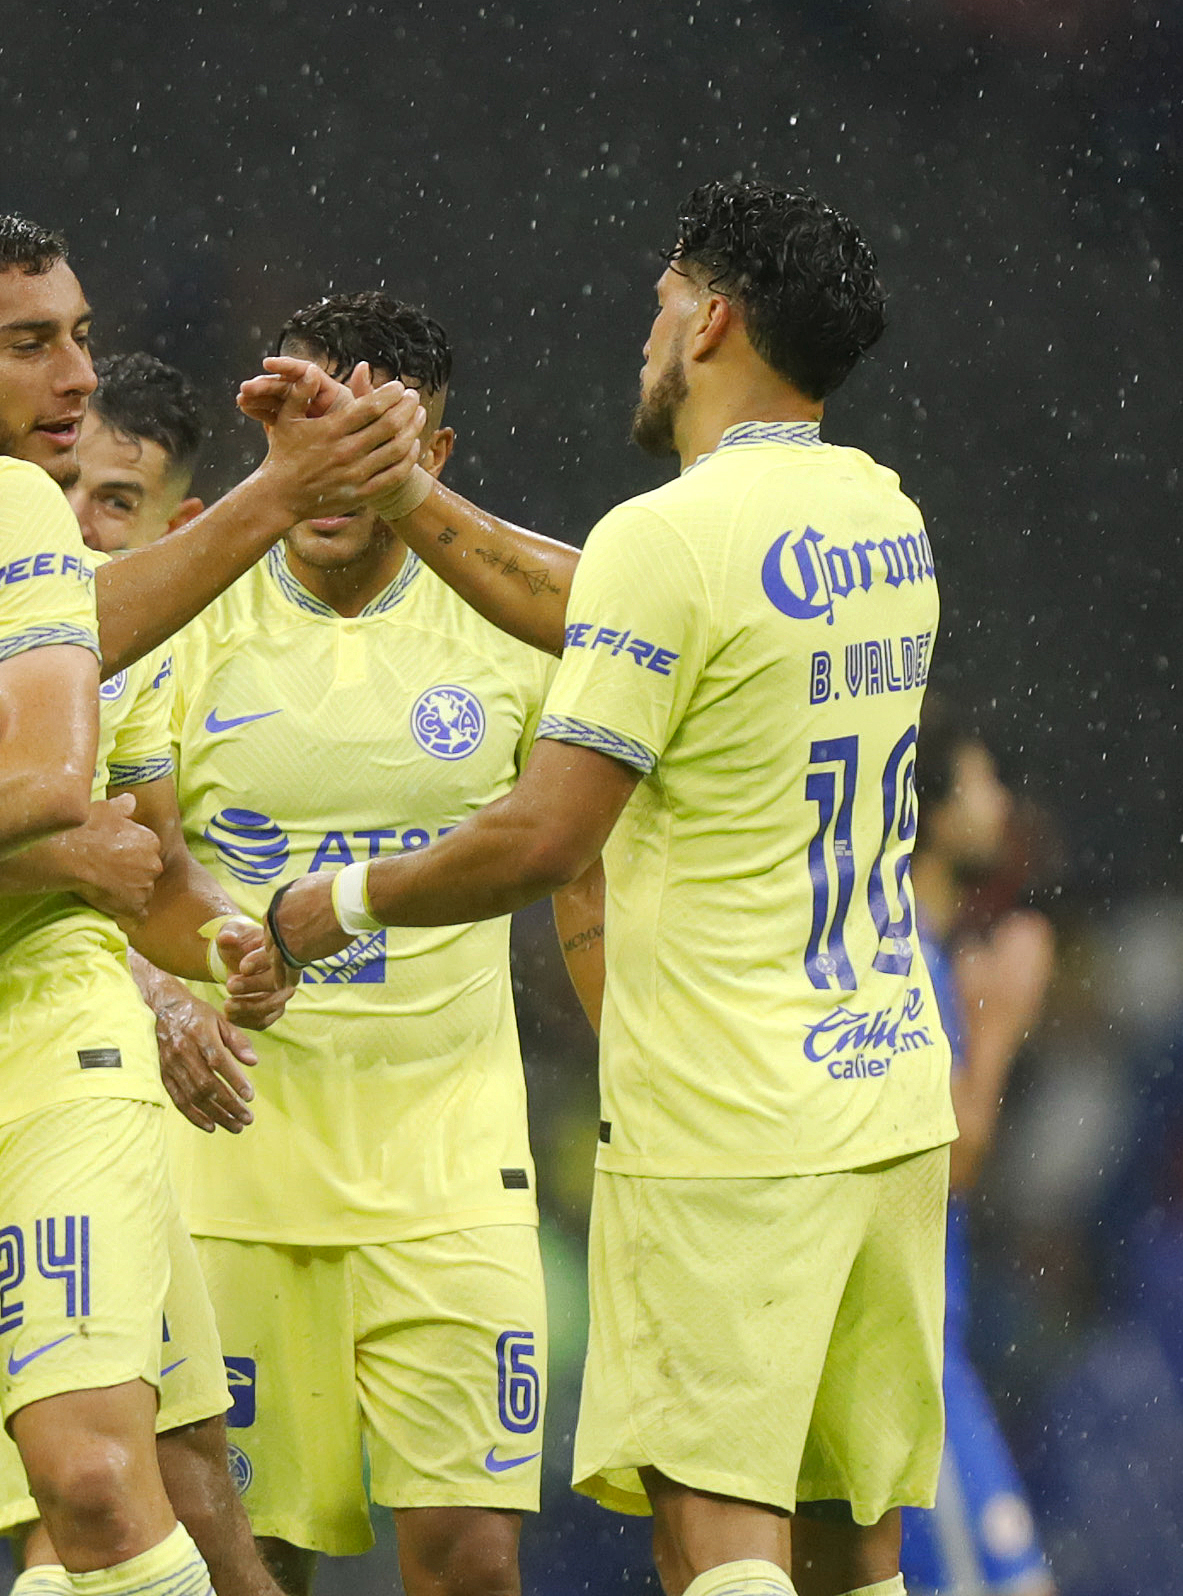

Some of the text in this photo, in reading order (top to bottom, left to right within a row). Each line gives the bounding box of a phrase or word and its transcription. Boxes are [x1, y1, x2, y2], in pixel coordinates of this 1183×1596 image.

[590, 628, 680, 676] FIRE
[308, 828, 459, 873] AT&
[496, 1331, 540, 1434] 6
